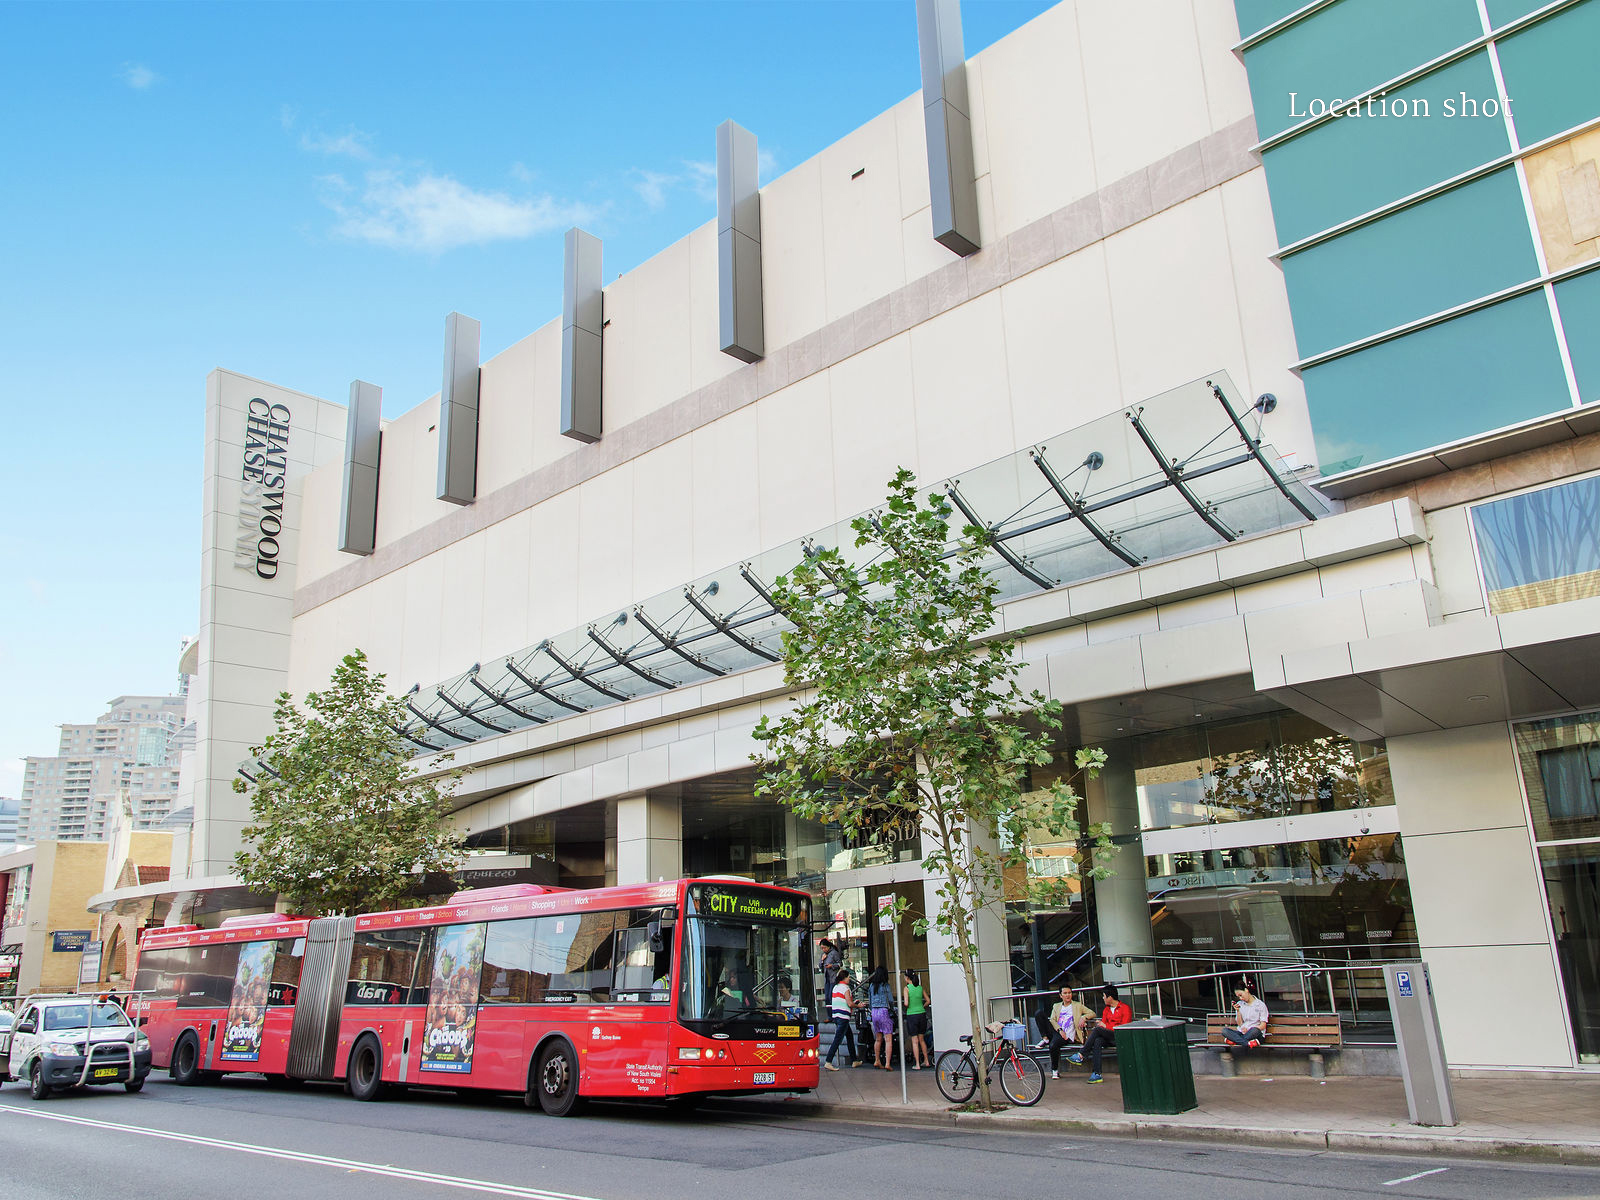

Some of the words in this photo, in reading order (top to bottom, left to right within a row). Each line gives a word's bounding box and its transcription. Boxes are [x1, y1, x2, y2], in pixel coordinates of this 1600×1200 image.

[242, 397, 271, 484] CHASE
[256, 403, 291, 580] CHATSWOOD
[659, 888, 677, 898] 2228
[419, 912, 435, 920] Theatre
[437, 910, 453, 919] School
[456, 908, 469, 918] Sport
[491, 904, 509, 913] Friends
[531, 899, 556, 911] Shopping
[574, 896, 590, 905] Work
[710, 893, 738, 913] CITY
[740, 905, 769, 915] FREEWAY
[748, 899, 760, 907] VIA
[770, 901, 792, 919] M40
[1398, 973, 1409, 986] P
[430, 1027, 468, 1048] CROODS
